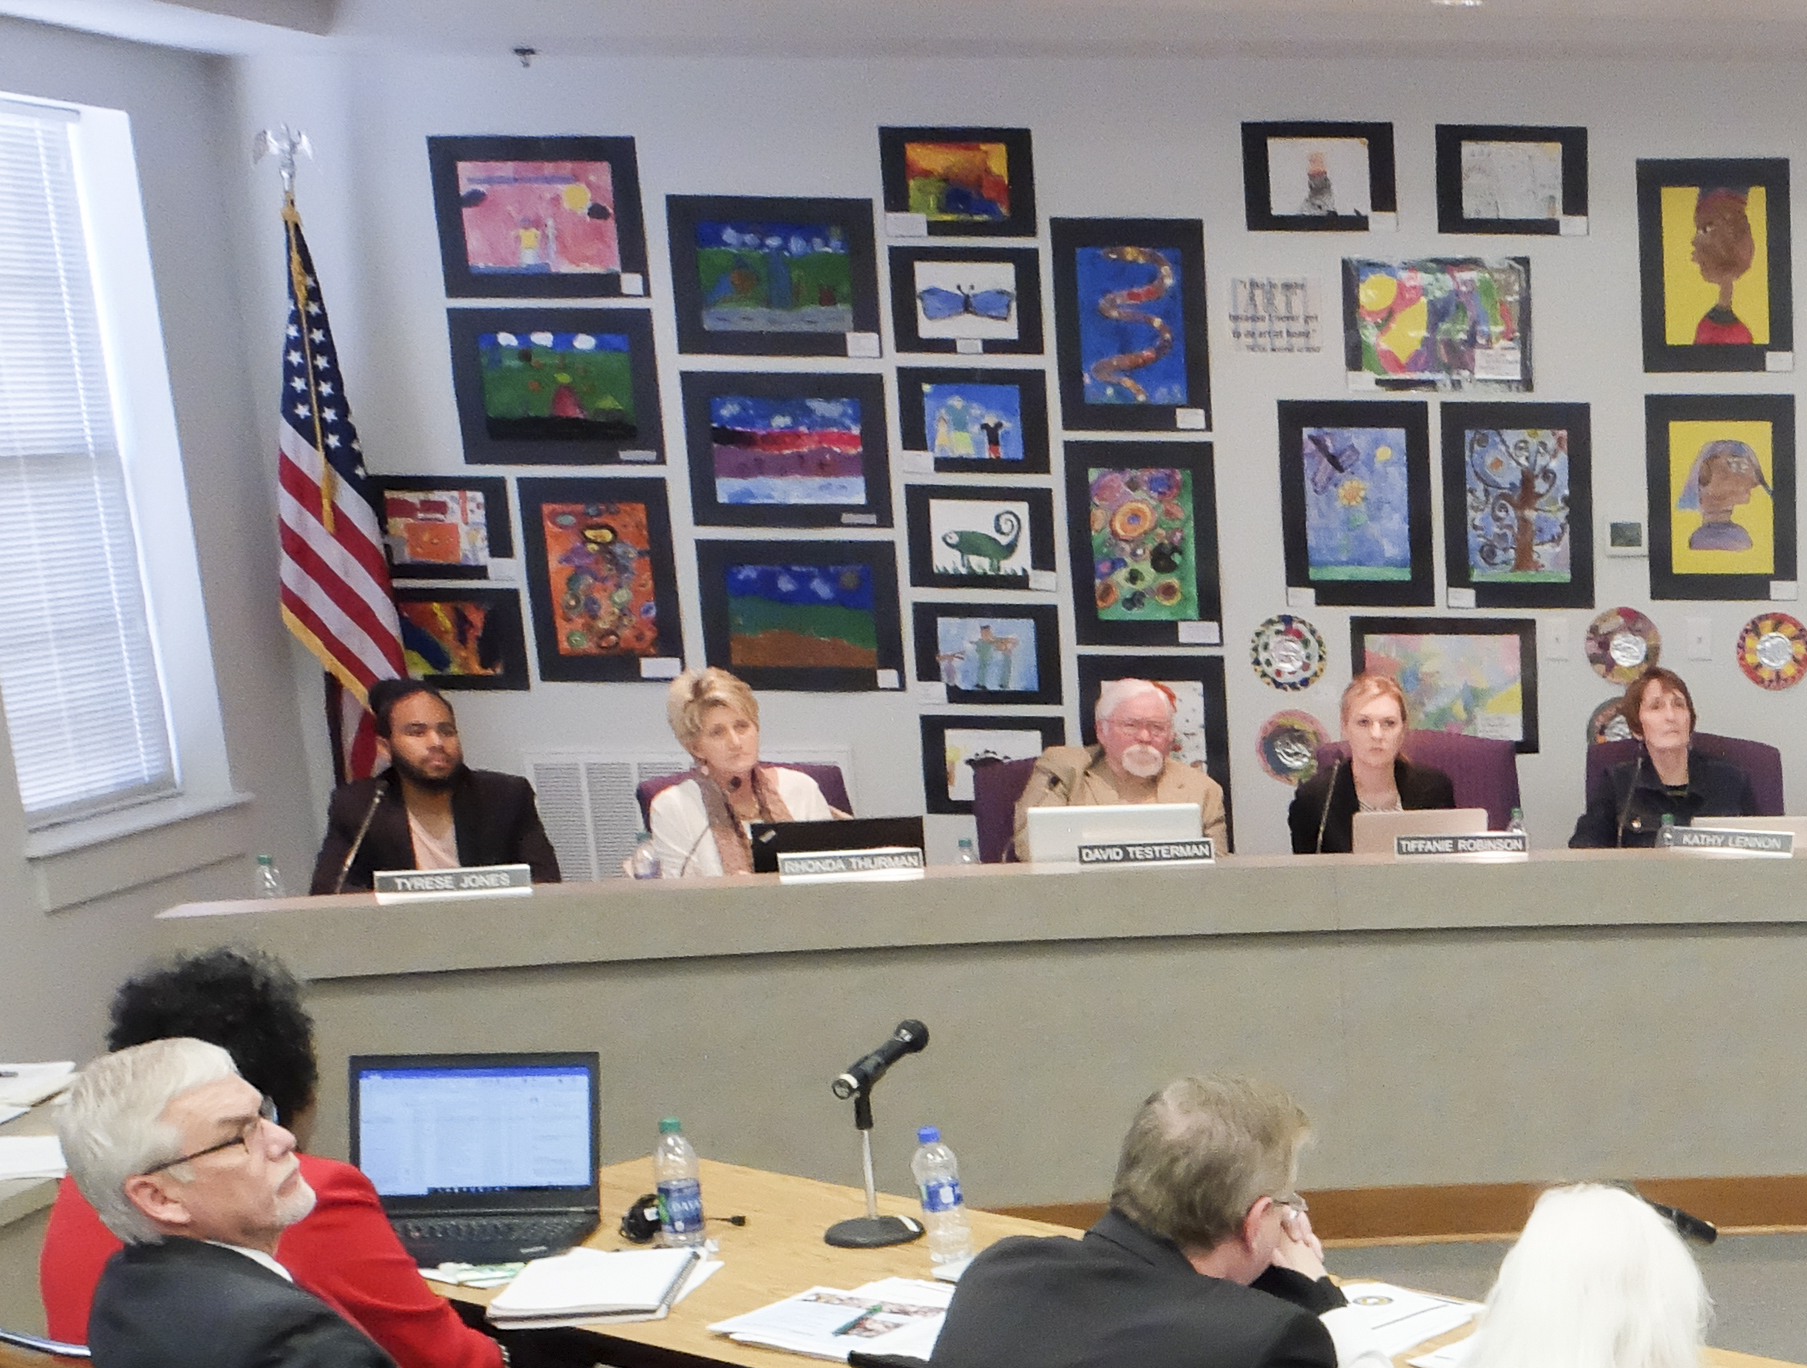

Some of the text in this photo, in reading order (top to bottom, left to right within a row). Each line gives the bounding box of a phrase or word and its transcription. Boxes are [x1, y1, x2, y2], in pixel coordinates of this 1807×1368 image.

[1399, 838, 1524, 853] TIFFANIE ROBINSON
[1682, 833, 1782, 849] KATHY LENNON
[1081, 844, 1210, 862] DAVID TESTERMAN
[784, 855, 919, 874] RHONDA THURMAN
[394, 872, 511, 892] TYRESE JONES
